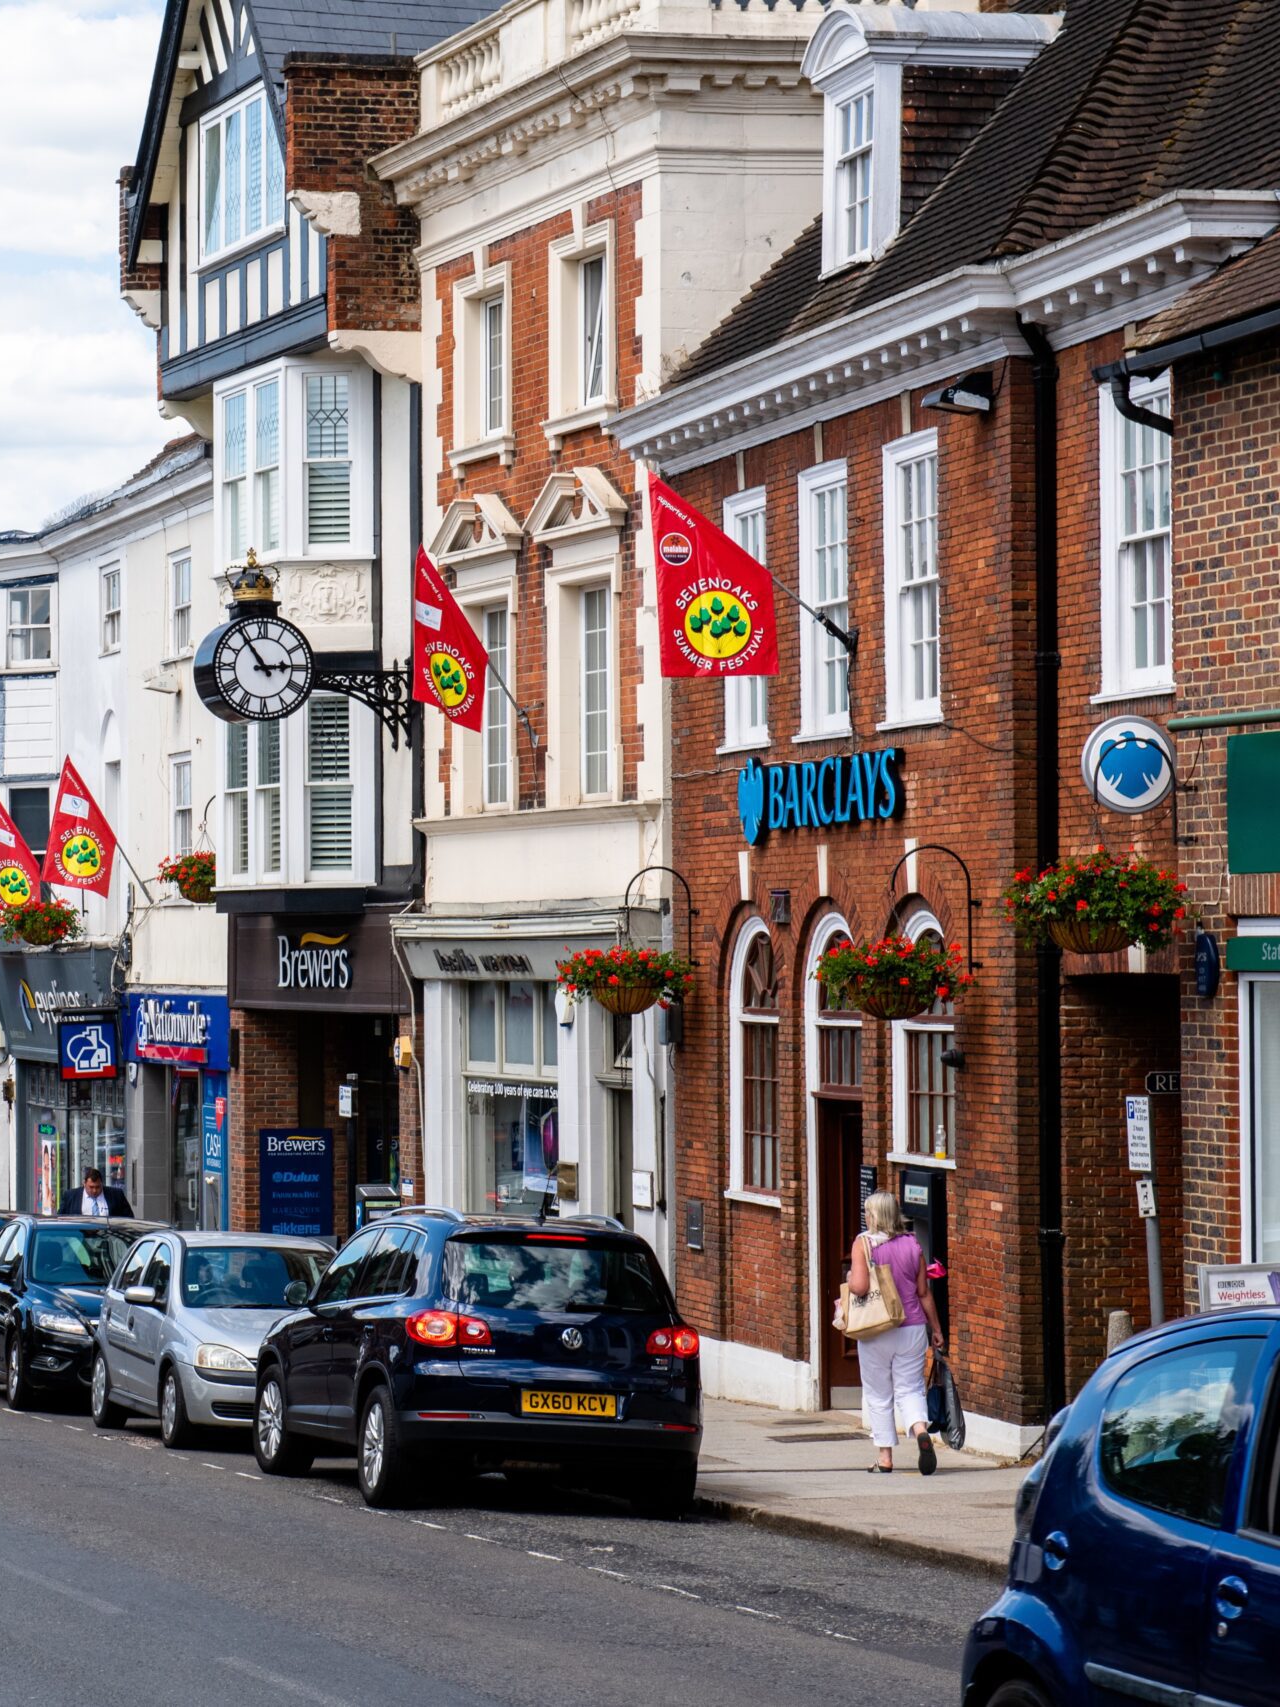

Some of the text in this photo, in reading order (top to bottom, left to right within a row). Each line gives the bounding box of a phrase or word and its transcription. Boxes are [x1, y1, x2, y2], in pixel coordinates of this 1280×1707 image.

[656, 495, 697, 529] supported by
[675, 577, 759, 611] SEVENOAKS
[673, 627, 764, 672] SUMMER FESTIVAL
[768, 747, 896, 829] BARCLAYS
[60, 826, 106, 856] SEVENOAKS
[54, 853, 106, 885] SUMMER FESTIVAL
[277, 935, 349, 989] Brewers
[147, 999, 206, 1044] Nationwide
[467, 1081, 494, 1097] Celebrating
[494, 1083, 503, 1095] 100
[503, 1085, 517, 1098] years
[517, 1084, 523, 1097] of
[523, 1087, 533, 1099] eye
[533, 1087, 544, 1098] care
[205, 1132, 222, 1157] CASH
[267, 1136, 326, 1151] Brewers
[283, 1172, 319, 1182] Dulux
[272, 1222, 320, 1235] sikkens
[1217, 1290, 1266, 1302] Weightless
[529, 1393, 572, 1410] GX60
